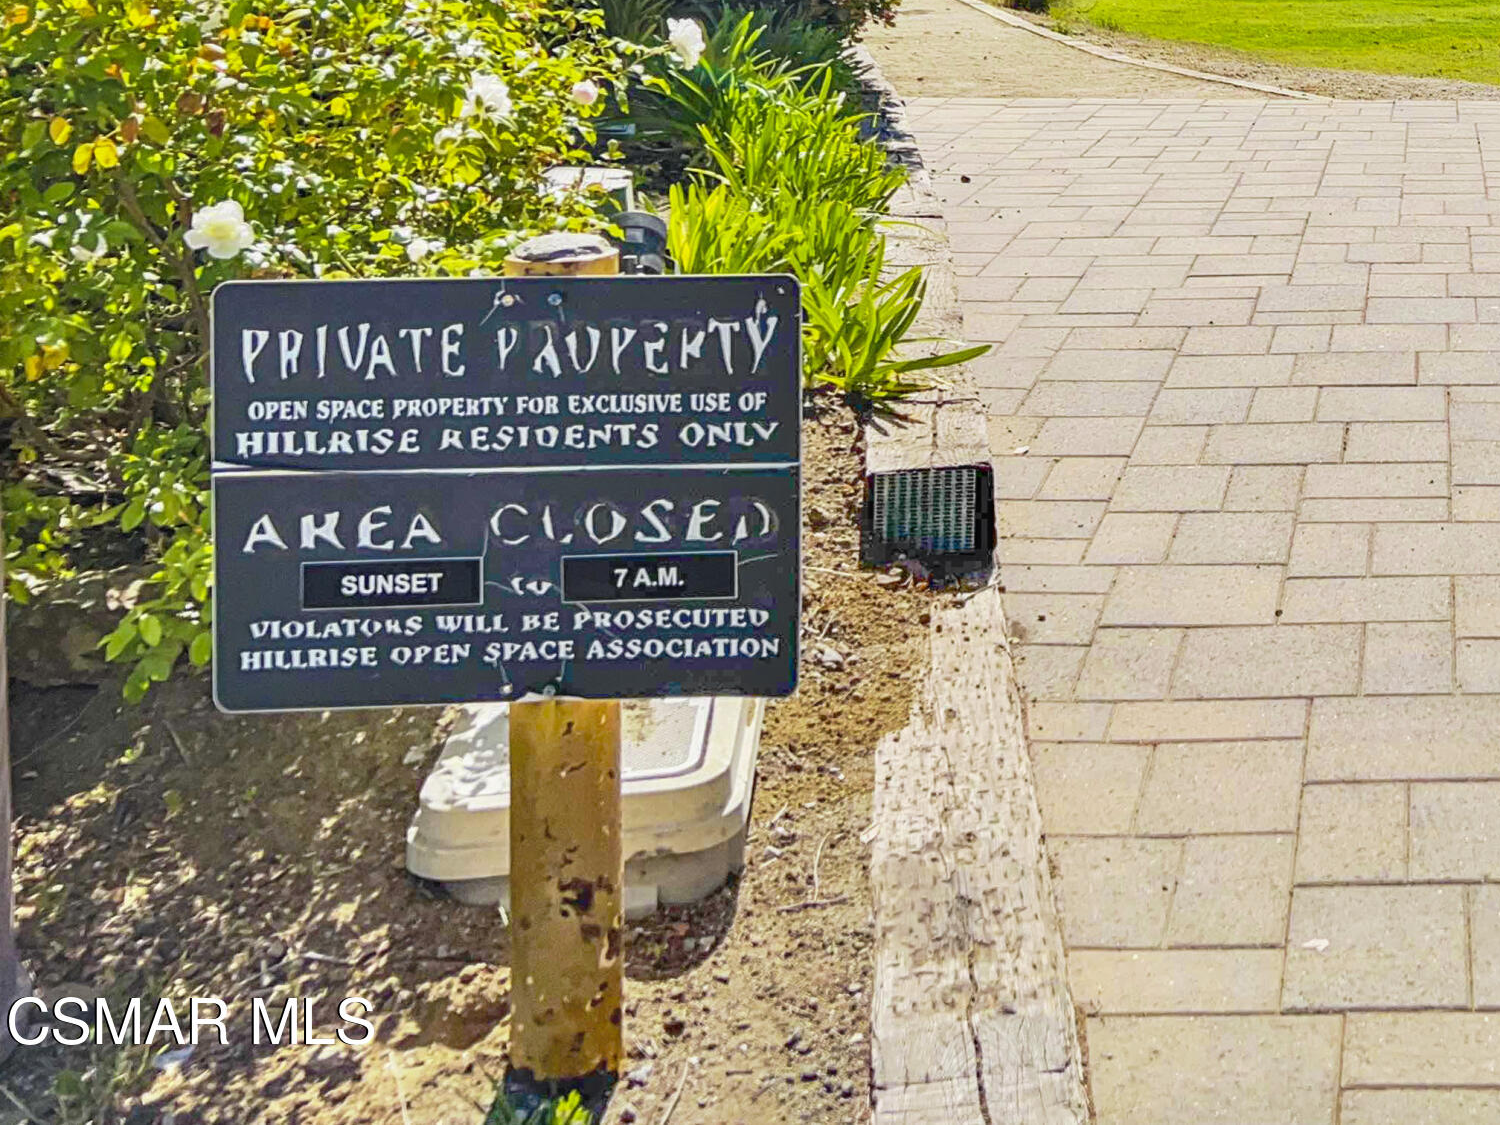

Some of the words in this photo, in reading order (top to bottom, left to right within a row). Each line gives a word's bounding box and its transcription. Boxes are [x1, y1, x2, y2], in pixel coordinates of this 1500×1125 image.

[241, 322, 465, 382] PRIVATE
[248, 400, 308, 421] OPEN
[316, 398, 384, 423] SPACE
[393, 396, 509, 419] PROPERTY
[517, 395, 558, 414] FOR
[568, 394, 682, 413] EXCLUSIVE
[690, 393, 730, 411] USE
[738, 392, 767, 411] OF
[235, 428, 420, 458] HILLRISE
[440, 422, 659, 451] RESIDENTS
[679, 421, 779, 447] ONLY
[242, 505, 442, 553] AREA
[490, 499, 779, 545] CLOSED
[341, 572, 443, 596] SUNSET
[614, 568, 626, 587] 7
[634, 567, 684, 587] A.M.
[249, 616, 423, 640] VIOLATORS
[436, 612, 509, 634] WILL
[523, 610, 559, 631] BE
[573, 606, 769, 631] PROSECUTED
[240, 646, 379, 670] HILLRISE
[390, 643, 471, 666] OPEN
[484, 641, 575, 662] SPACE
[586, 638, 780, 661] ASSOCIATION
